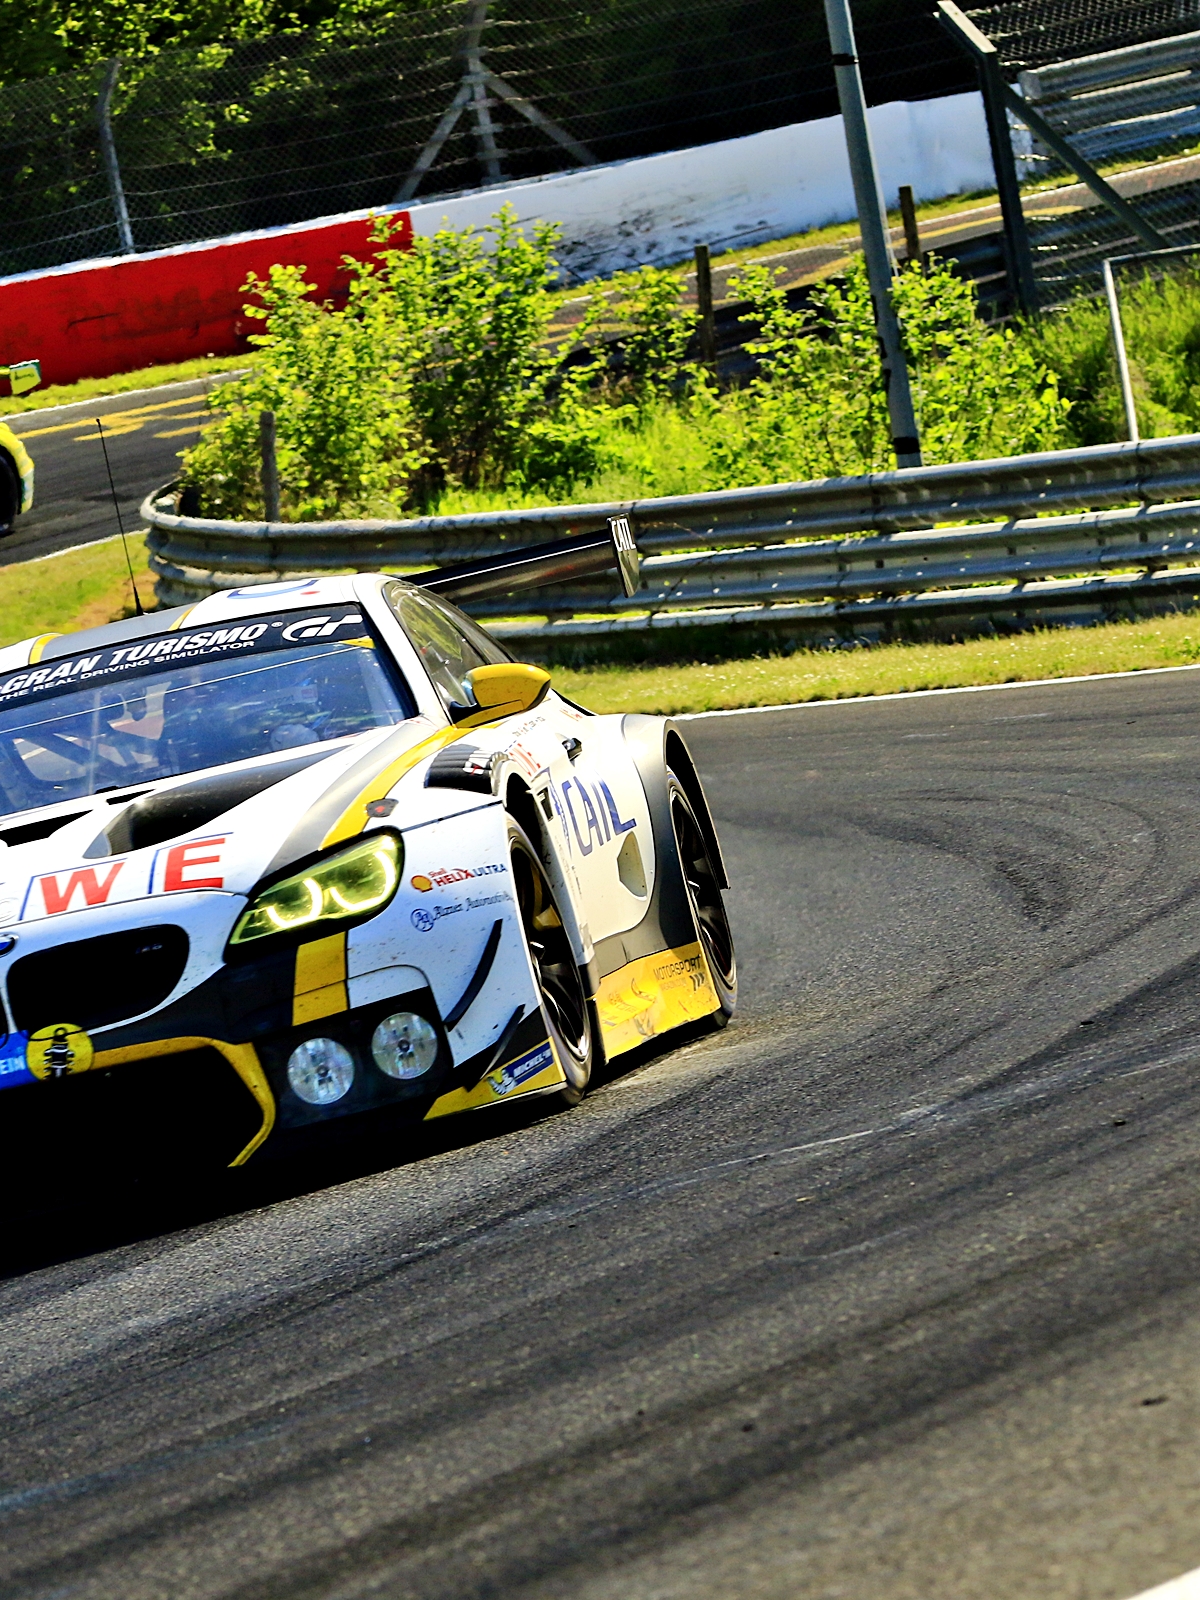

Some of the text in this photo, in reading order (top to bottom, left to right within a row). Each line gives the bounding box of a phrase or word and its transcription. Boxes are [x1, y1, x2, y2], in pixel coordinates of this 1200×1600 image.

[0, 654, 103, 695] GRAN
[108, 623, 269, 667] TURISMO
[32, 677, 77, 693] REAL
[80, 659, 150, 680] DRIVING
[153, 640, 255, 664] SIMULATOR
[433, 863, 508, 887] HELIX ULTRA
[653, 954, 702, 980] MOTORSPORT
